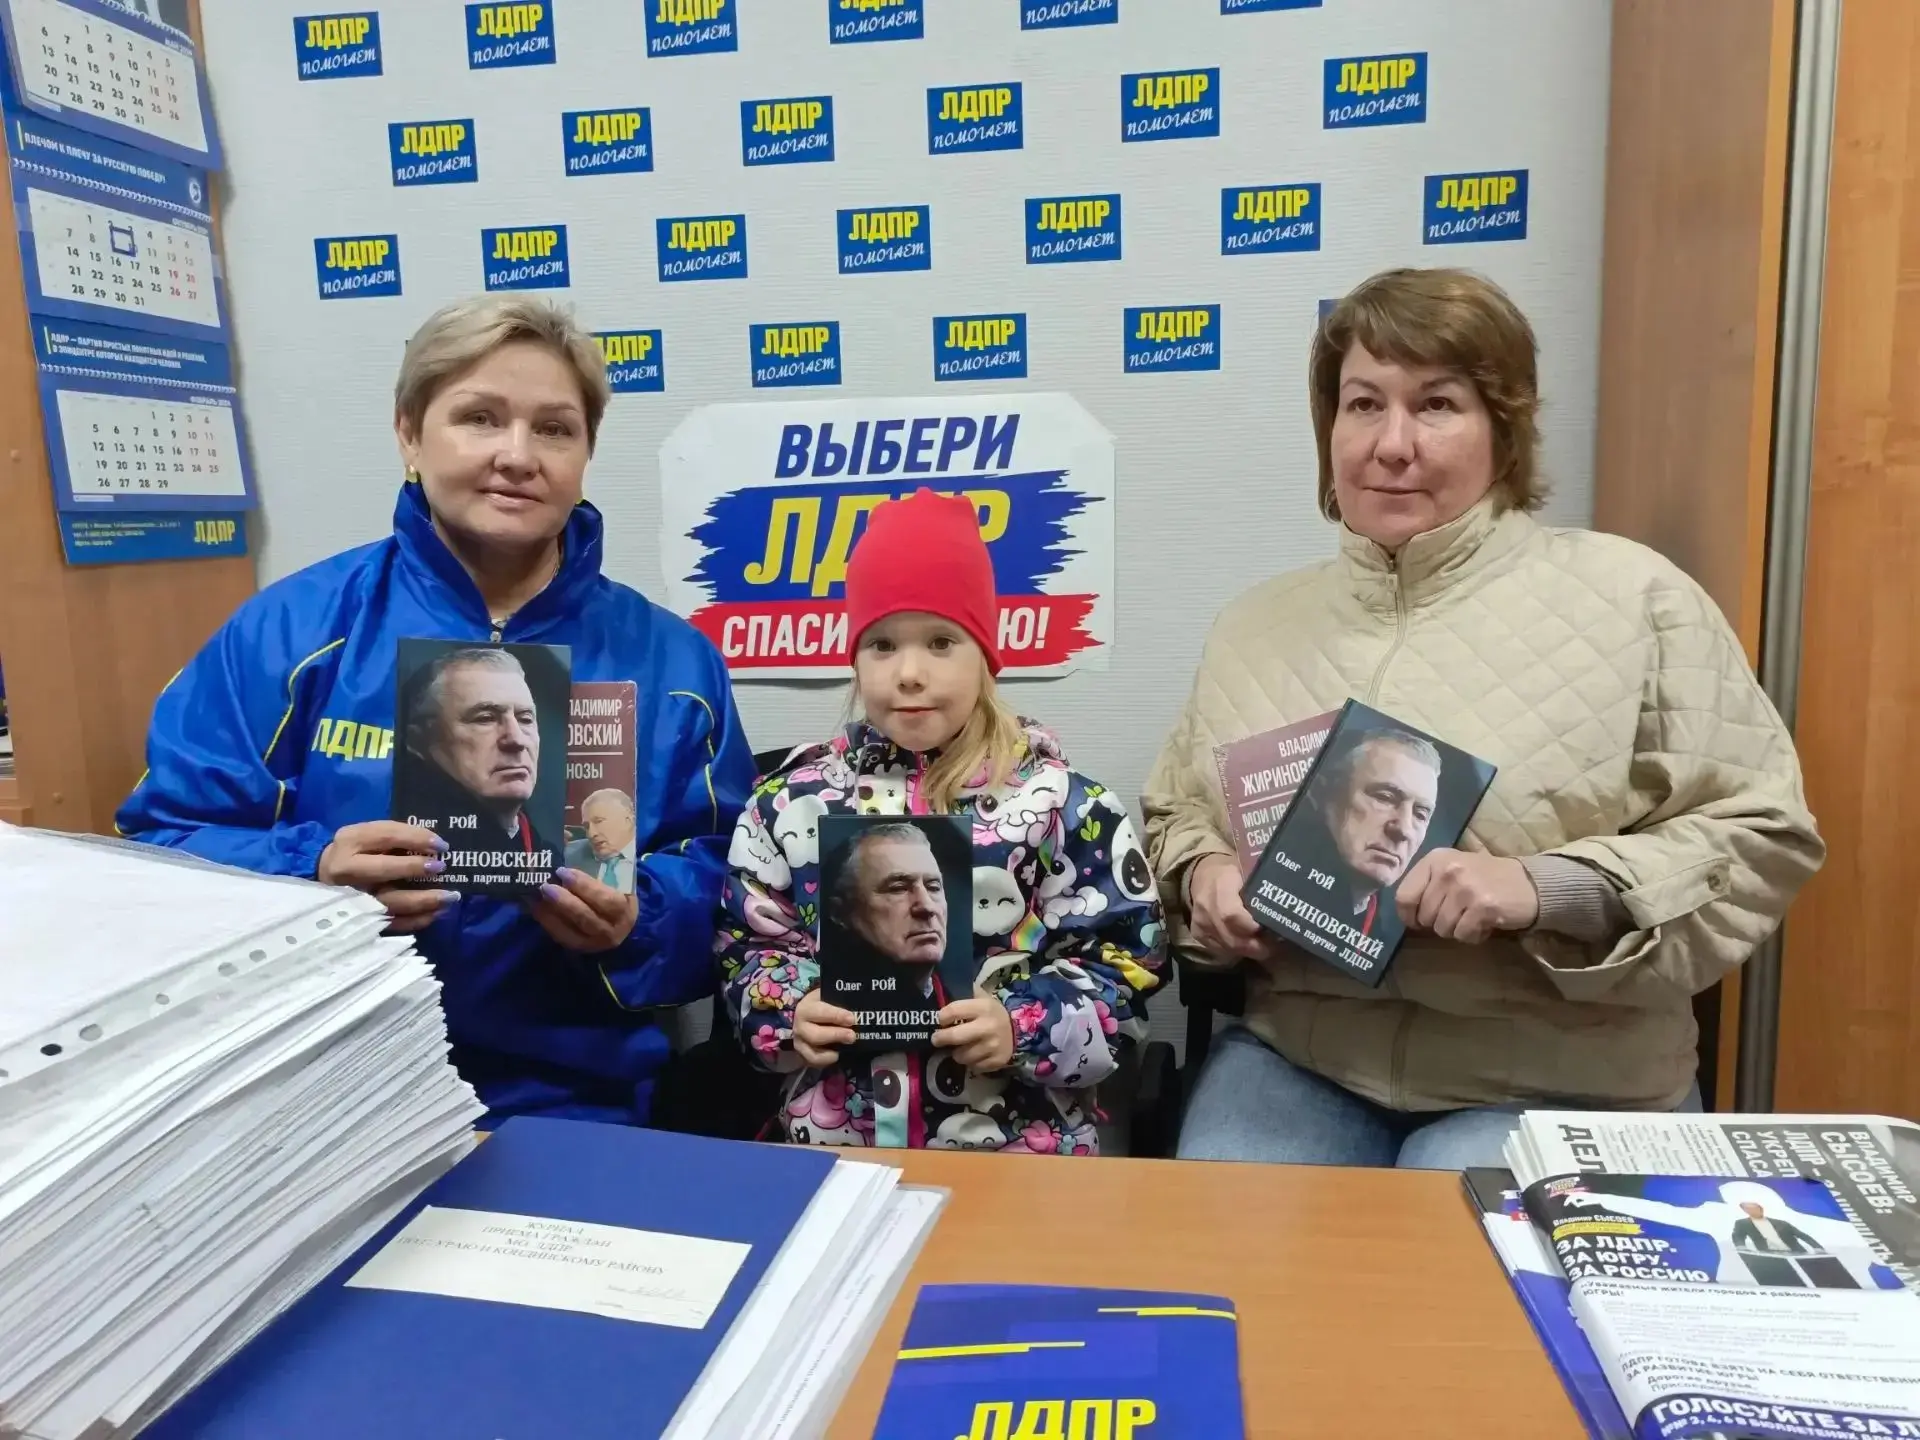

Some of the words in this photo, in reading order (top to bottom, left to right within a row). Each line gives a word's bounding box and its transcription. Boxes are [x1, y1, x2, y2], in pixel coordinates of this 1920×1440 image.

[477, 5, 543, 37] ЛДПР
[657, 0, 724, 26] ЛДПР
[835, 10, 918, 38] ПОМОГАЕТ
[306, 18, 369, 50] ЛДПР
[651, 23, 731, 52] ПОМОГАЕТ
[302, 48, 376, 74] ПОМОГАЕТ
[473, 36, 550, 63] ПОМОГАЕТ
[1337, 59, 1417, 96] ЛДПР
[940, 89, 1012, 123] ЛДПР
[1133, 75, 1209, 110] ЛДПР
[754, 103, 822, 135] ЛДПР
[1126, 108, 1214, 136] ПОМОГАЕТ
[1328, 93, 1420, 123] ПОМОГАЕТ
[401, 125, 466, 156] ЛДПР
[574, 114, 641, 145] ЛДПР
[933, 122, 1017, 148] ПОМОГАЕТ
[24, 132, 58, 152] ПЛЕЧОМ
[66, 145, 90, 161] ПЛЕЧУ
[92, 153, 102, 165] ЗА
[569, 145, 647, 171] ПОМОГАЕТ
[748, 133, 828, 160] ПОМОГАЕТ
[396, 154, 472, 181] ПОМОГАЕТ
[1234, 190, 1310, 223] ЛДПР
[1436, 176, 1518, 211] ЛДПР
[849, 212, 919, 243] ЛДПР
[1038, 201, 1110, 232] ЛДПР
[1427, 210, 1521, 239] ПОМОГАЕТ
[494, 231, 558, 261] ЛДПР
[669, 221, 735, 252] ЛДПР
[1031, 233, 1115, 258] ПОМОГАЕТ
[1226, 222, 1314, 249] ПОМОГАЕТ
[326, 241, 389, 270] ЛДПР
[663, 252, 741, 276] ПОМОГАЕТ
[843, 243, 925, 268] ПОМОГАЕТ
[322, 269, 396, 295] ПОМОГАЕТ
[488, 261, 564, 286] ПОМОГАЕТ
[945, 320, 1016, 351] ЛДПР
[1137, 310, 1210, 342] ЛДПР
[594, 335, 652, 365] ДПР
[762, 327, 830, 358] ЛДПР
[1129, 342, 1214, 367] ПОМОГАЕТ
[606, 365, 658, 384] ОГАЕТ
[756, 358, 835, 382] ПОМОГАЕТ
[939, 351, 1021, 375] ПОМОГАЕТ
[93, 441, 105, 451] 12
[114, 443, 125, 452] 13
[134, 444, 145, 453] 14
[153, 446, 164, 455] 15
[172, 447, 182, 455] 16
[190, 448, 199, 456] 17
[208, 449, 217, 457] 18
[188, 431, 197, 439] 10
[205, 432, 214, 440] 11
[774, 414, 1021, 479] ВЫБЕРИ
[96, 460, 107, 469] 19
[116, 461, 128, 470] 20
[136, 462, 147, 470] 21
[156, 463, 166, 472] 22
[174, 464, 184, 472] 23
[192, 464, 201, 473] 24
[209, 465, 219, 473] 25
[98, 478, 110, 488] 26
[119, 479, 130, 487] 27
[139, 479, 150, 488] 28
[157, 480, 168, 488] 29
[194, 520, 235, 545] ЛДПР
[743, 488, 1011, 597] ЛДР
[721, 612, 848, 659] СПАСИ
[407, 815, 438, 828] Олег
[449, 814, 478, 829] РОЙ
[1242, 807, 1270, 829] МОИ
[473, 874, 511, 885] партии
[515, 872, 552, 885] ЛДПР
[1275, 851, 1301, 872] Олег
[1307, 868, 1336, 890] РОЙ
[1250, 896, 1301, 933] Основатель
[1303, 929, 1337, 953] партии
[1338, 947, 1374, 971] ЛДПР
[1257, 879, 1384, 959] ЖИРИНОВСКИЙ
[835, 979, 862, 991] Олег
[871, 977, 897, 991] РОЙ
[895, 1030, 929, 1042] партии
[1731, 1130, 1773, 1177] СПАСА
[1757, 1130, 1800, 1177] УКРЕП
[1783, 1130, 1827, 1167] ЛДПР
[1820, 1131, 1895, 1215] СЫСОЕВ:
[1848, 1131, 1917, 1204] ВЛАДИМИР
[525, 1221, 584, 1234] ЖУРНАЛ
[1556, 1236, 1591, 1255] ЗА
[1596, 1235, 1677, 1253] ЛДПР.
[607, 1260, 664, 1275] РАЙОНУ
[1563, 1252, 1596, 1268] ЗА
[1597, 1252, 1669, 1267] ЮГРУ.
[1568, 1265, 1600, 1282] ЗА
[1603, 1265, 1710, 1282] РОССИЮ
[953, 1399, 1156, 1440] ЛДПР
[1652, 1397, 1841, 1429] ГОЛОСУЙТЕ
[1842, 1416, 1893, 1435] ЗА
